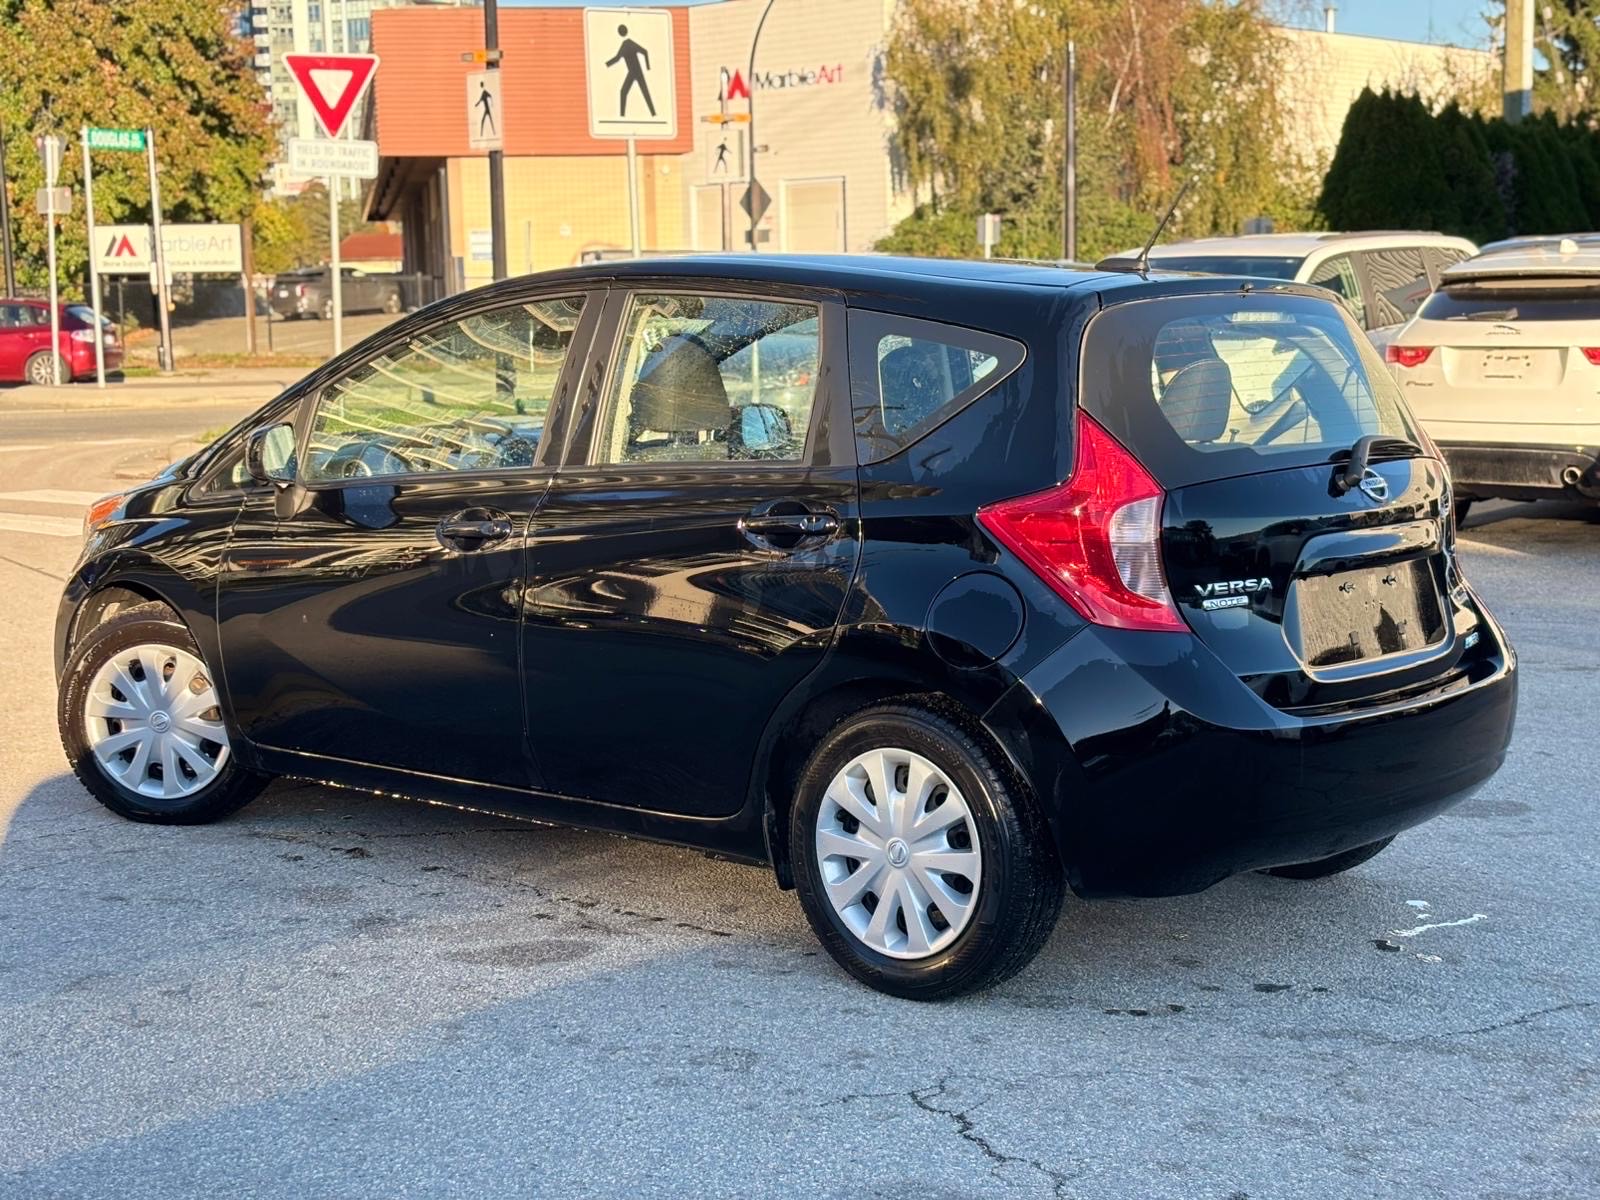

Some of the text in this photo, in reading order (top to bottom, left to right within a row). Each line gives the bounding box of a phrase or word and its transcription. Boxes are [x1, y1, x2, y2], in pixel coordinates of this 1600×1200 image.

[753, 65, 842, 90] MarbleArt
[297, 145, 371, 159] YIELD TO TRAFFIC
[311, 159, 370, 171] ROUNDABOUT
[1194, 577, 1273, 597] VERSA
[1208, 597, 1245, 609] NOTE
